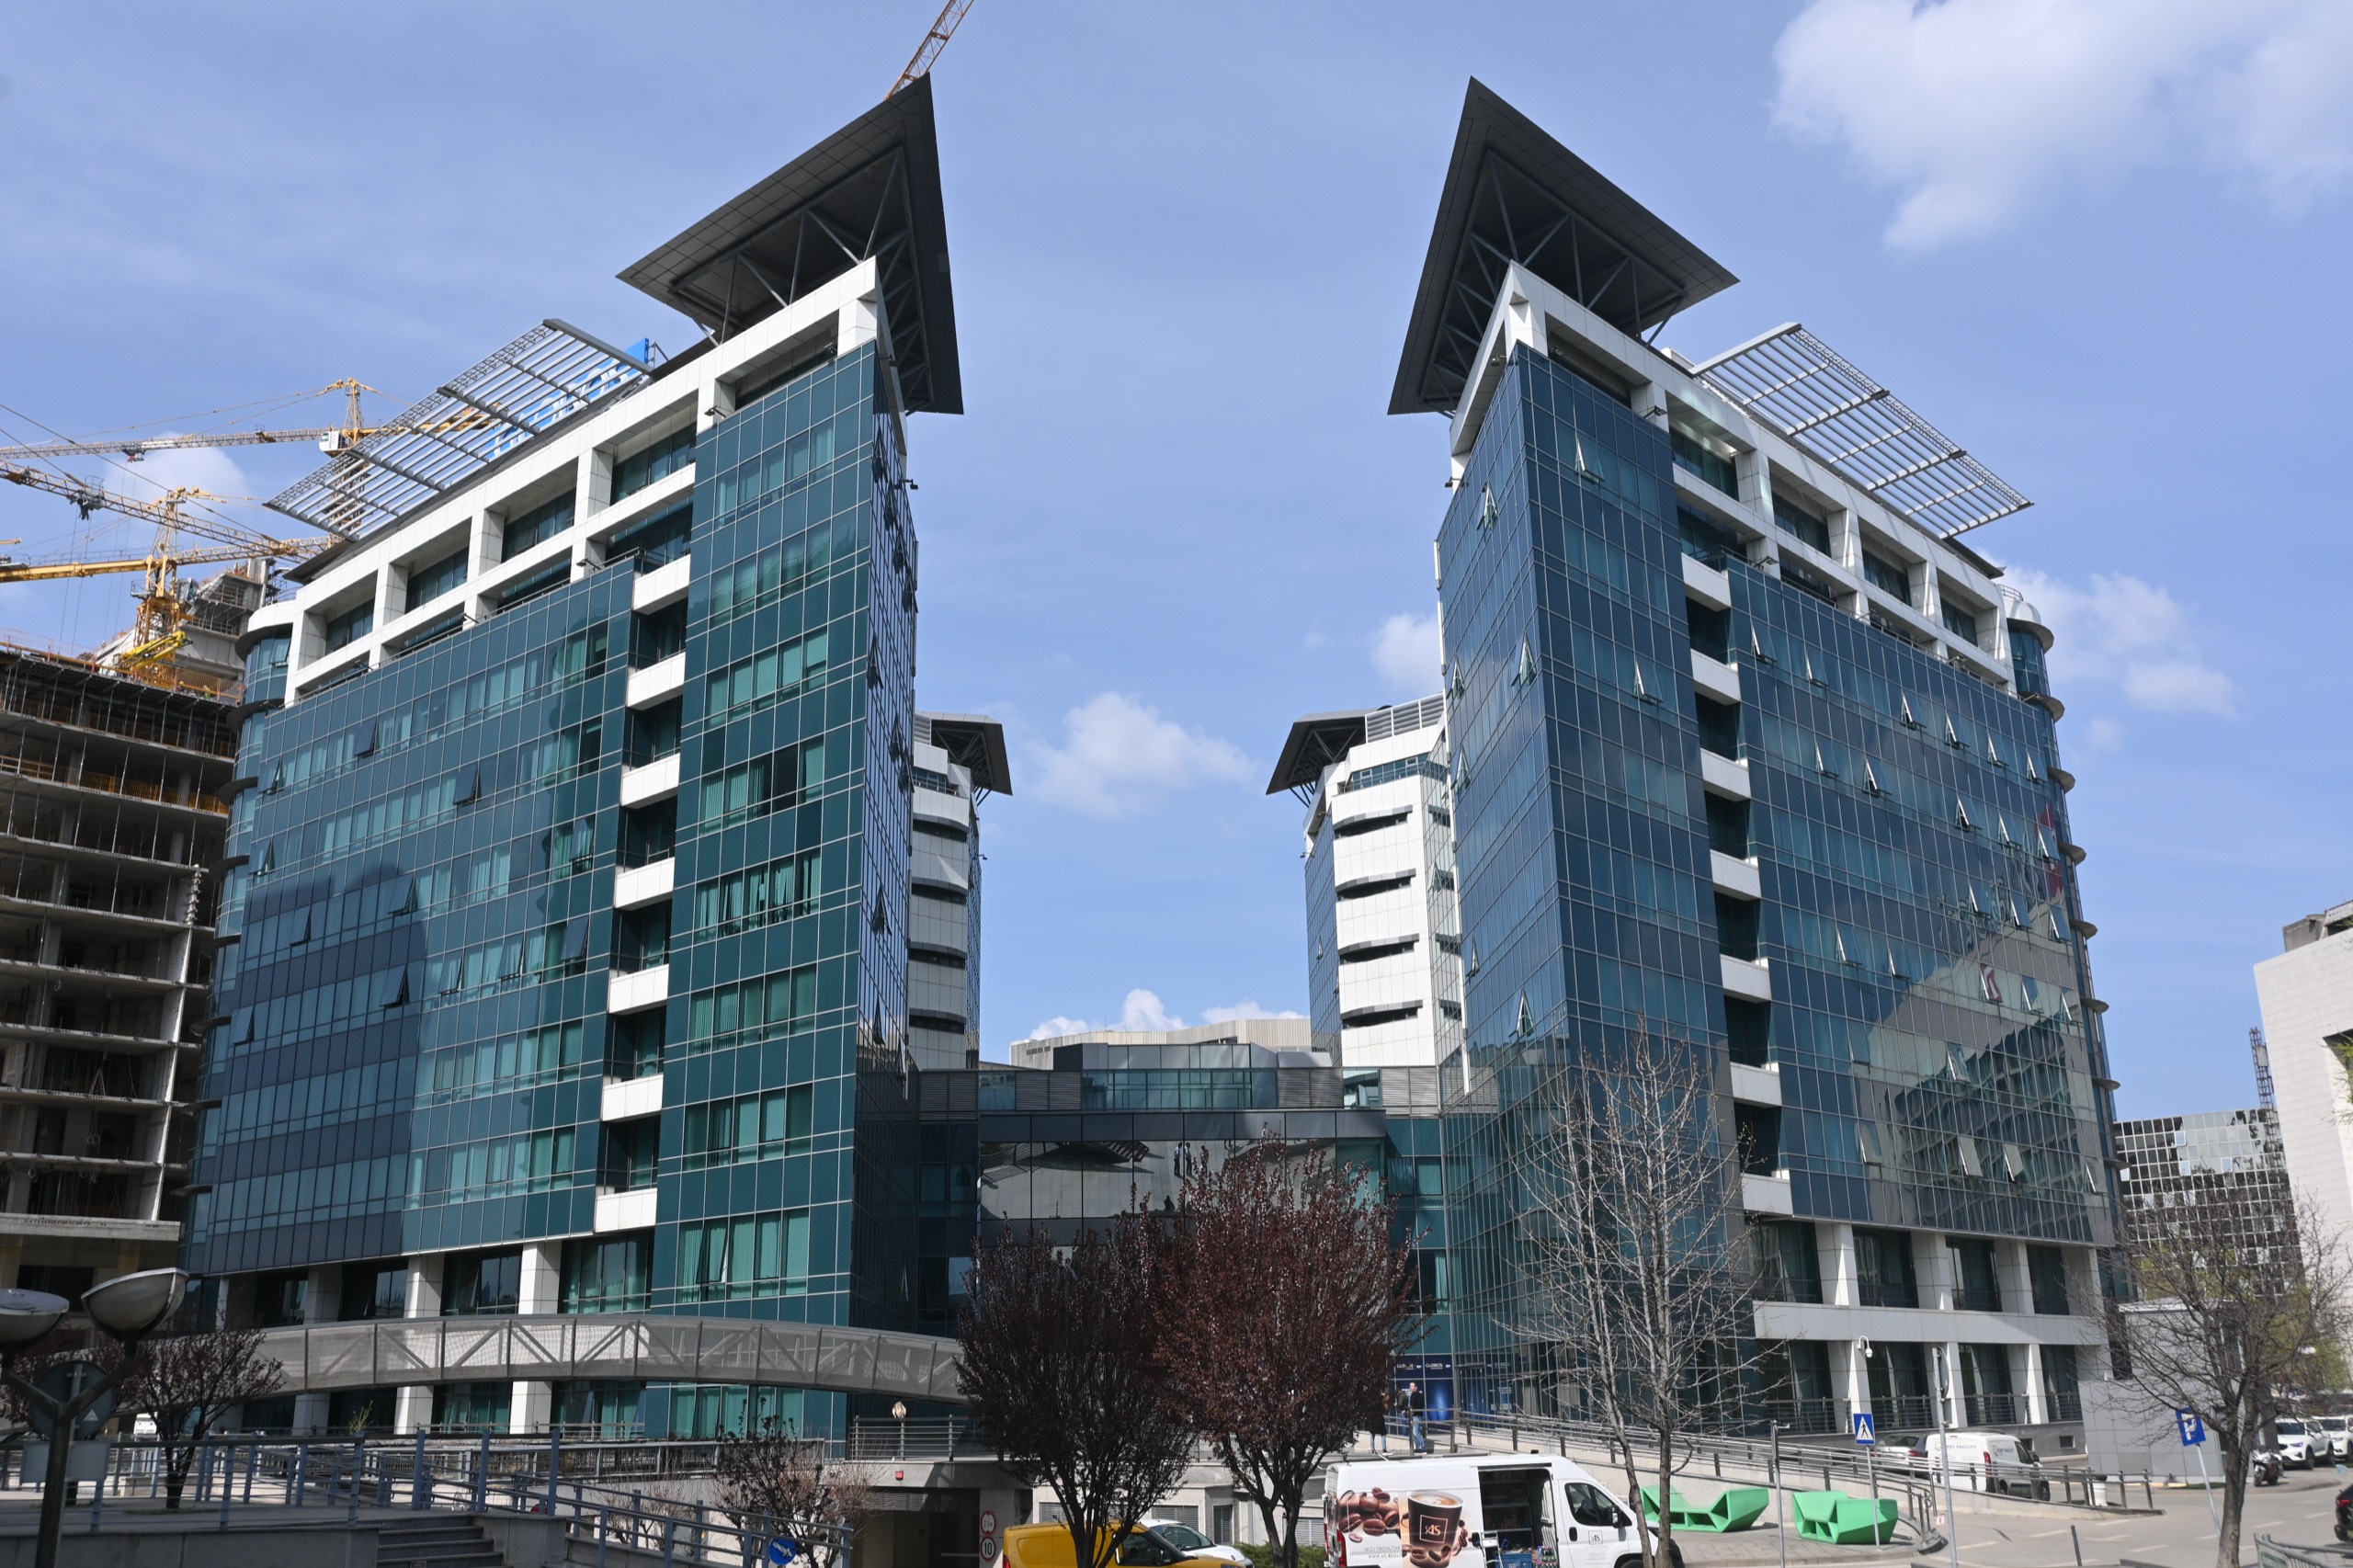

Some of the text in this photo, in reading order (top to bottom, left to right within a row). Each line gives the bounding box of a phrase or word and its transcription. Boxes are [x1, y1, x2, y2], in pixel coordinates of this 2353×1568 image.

[2181, 1413, 2197, 1440] P
[1425, 1525, 1441, 1536] AS
[984, 1542, 993, 1555] 10
